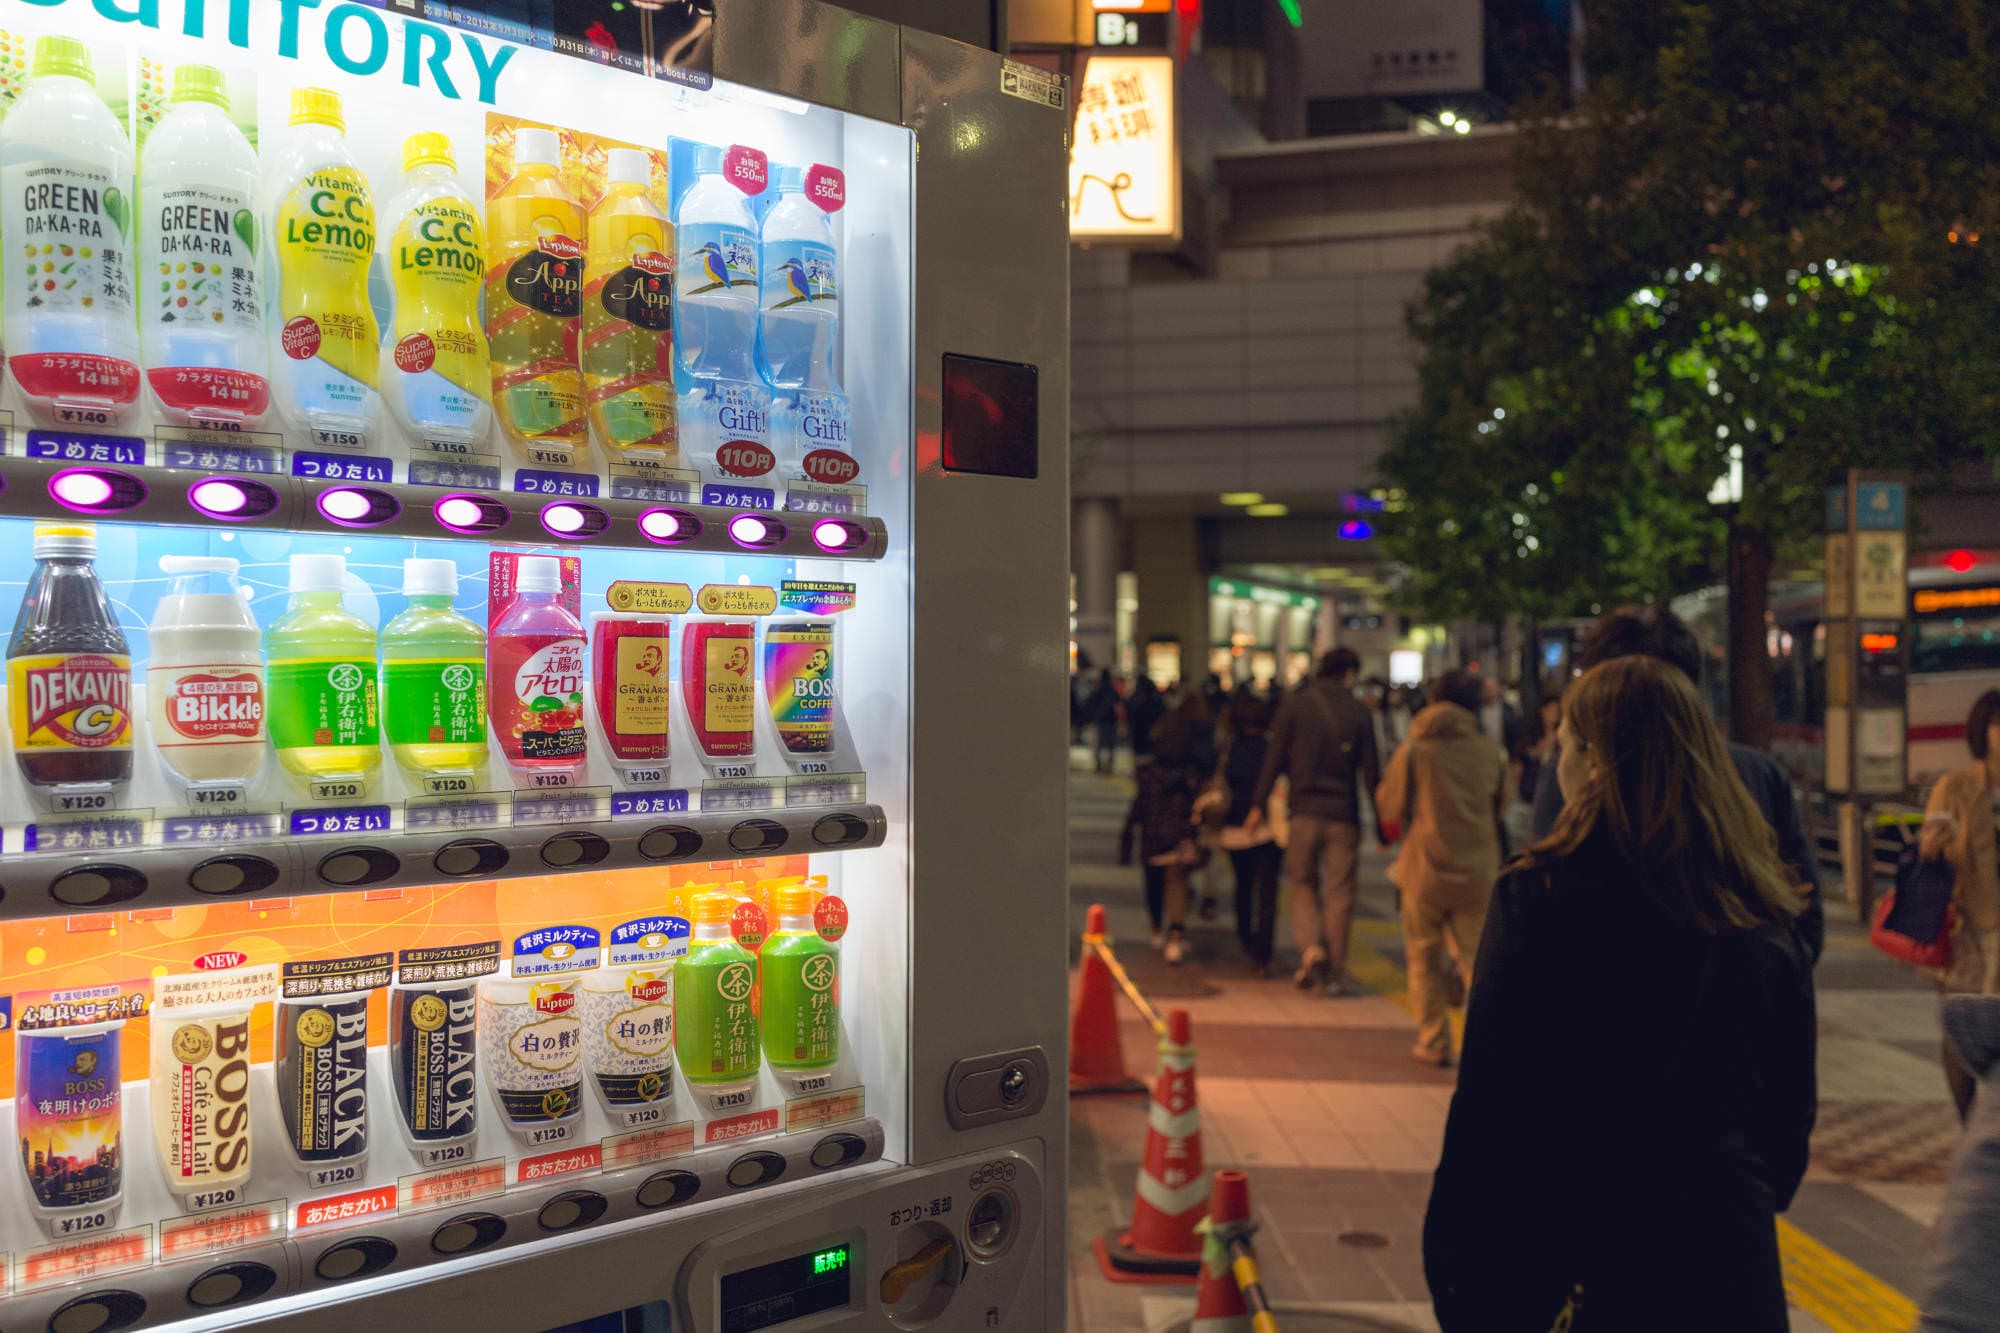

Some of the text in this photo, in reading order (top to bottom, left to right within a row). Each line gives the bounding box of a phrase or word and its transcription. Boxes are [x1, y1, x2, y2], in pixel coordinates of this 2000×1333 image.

[1096, 12, 1139, 46] B1
[735, 166, 765, 183] 550ml
[24, 183, 99, 216] GREEN
[815, 184, 843, 201] 550ml
[311, 190, 370, 226] C.C.
[414, 205, 474, 223] Vitamin
[161, 205, 229, 235] GREEN
[288, 217, 375, 254] Lemon
[420, 218, 479, 250] C.C.
[542, 237, 580, 253] Lipton
[400, 246, 485, 280] Lemon
[636, 255, 671, 270] Lipton
[542, 291, 572, 305] TEA
[283, 322, 317, 342] Super
[435, 329, 476, 343] ビタミンC
[284, 333, 320, 351] Vitamin
[396, 338, 430, 357] Super
[300, 345, 311, 358] C
[397, 348, 434, 366] Vitamin
[42, 357, 134, 377] カラダにいいもの
[415, 359, 425, 372] C
[176, 371, 264, 390] カラダにいいもの
[61, 410, 107, 424] ¥140
[718, 406, 766, 433] Gift!
[803, 415, 848, 442] Gift!
[319, 431, 358, 445] ¥150
[38, 440, 135, 462] つめたい
[431, 442, 467, 454] ¥150
[535, 451, 568, 464] ¥150
[722, 448, 772, 470] 110円
[301, 460, 384, 481] つめたい
[808, 456, 855, 478] 110円
[523, 478, 591, 496] つめたい
[620, 486, 683, 502] つめたい
[709, 492, 768, 509] つめたい
[636, 598, 685, 609] もっとも香るボス
[724, 600, 770, 610] もっとも香るボス
[552, 646, 579, 655] ニチレイ
[331, 665, 360, 689] 茶
[444, 666, 471, 689] 茶
[620, 684, 650, 694] GRAN
[709, 683, 737, 694] GRAN
[176, 695, 261, 722] Bikkle
[449, 691, 468, 742] 伊右衛門
[74, 702, 114, 737] C
[336, 692, 357, 744] 伊右衛門
[631, 771, 660, 782] ¥120
[719, 766, 747, 777] ¥120
[801, 762, 827, 773] ¥120
[432, 779, 466, 791] ¥120
[535, 775, 567, 786] ¥120
[196, 790, 236, 803] ¥120
[318, 784, 356, 797] ¥120
[62, 796, 105, 809] ¥120
[618, 798, 681, 812] つめたい
[300, 815, 382, 831] つめたい
[736, 908, 763, 920] ふわっと
[817, 902, 845, 913] ふわっと
[743, 921, 757, 932] 香る
[825, 915, 838, 924] 香る
[617, 919, 686, 941] 贅沢ミルクティー
[521, 929, 595, 950] 贅沢ミルクティー
[204, 953, 240, 968] NEW
[720, 965, 751, 998] 茶
[804, 957, 833, 988] 茶
[635, 983, 667, 998] Lipton
[539, 995, 574, 1012] Lipton
[810, 993, 829, 1059] 伊右衛門
[727, 1003, 748, 1072] 伊右衛門
[430, 1031, 445, 1074] BOSS
[446, 993, 476, 1130] BLACK
[317, 1047, 332, 1095] BOSS
[334, 1008, 366, 1150] BLACK
[65, 1078, 105, 1095] BOSS
[800, 1078, 825, 1091] ¥120
[214, 1016, 249, 1173] BOSS
[718, 1093, 745, 1106] ¥120
[194, 1066, 213, 1176] Café au Lait
[628, 1110, 659, 1124] ¥120
[533, 1127, 566, 1142] ¥120
[711, 1118, 772, 1141] あたたかい
[429, 1146, 464, 1162] ¥120
[316, 1167, 355, 1184] ¥120
[526, 1154, 595, 1179] あたたかい
[196, 1189, 235, 1207] ¥120
[306, 1194, 387, 1224] あたたかい
[889, 1195, 952, 1227] おつり・返却
[61, 1213, 105, 1231] ¥120
[814, 1248, 847, 1274] 販売中
